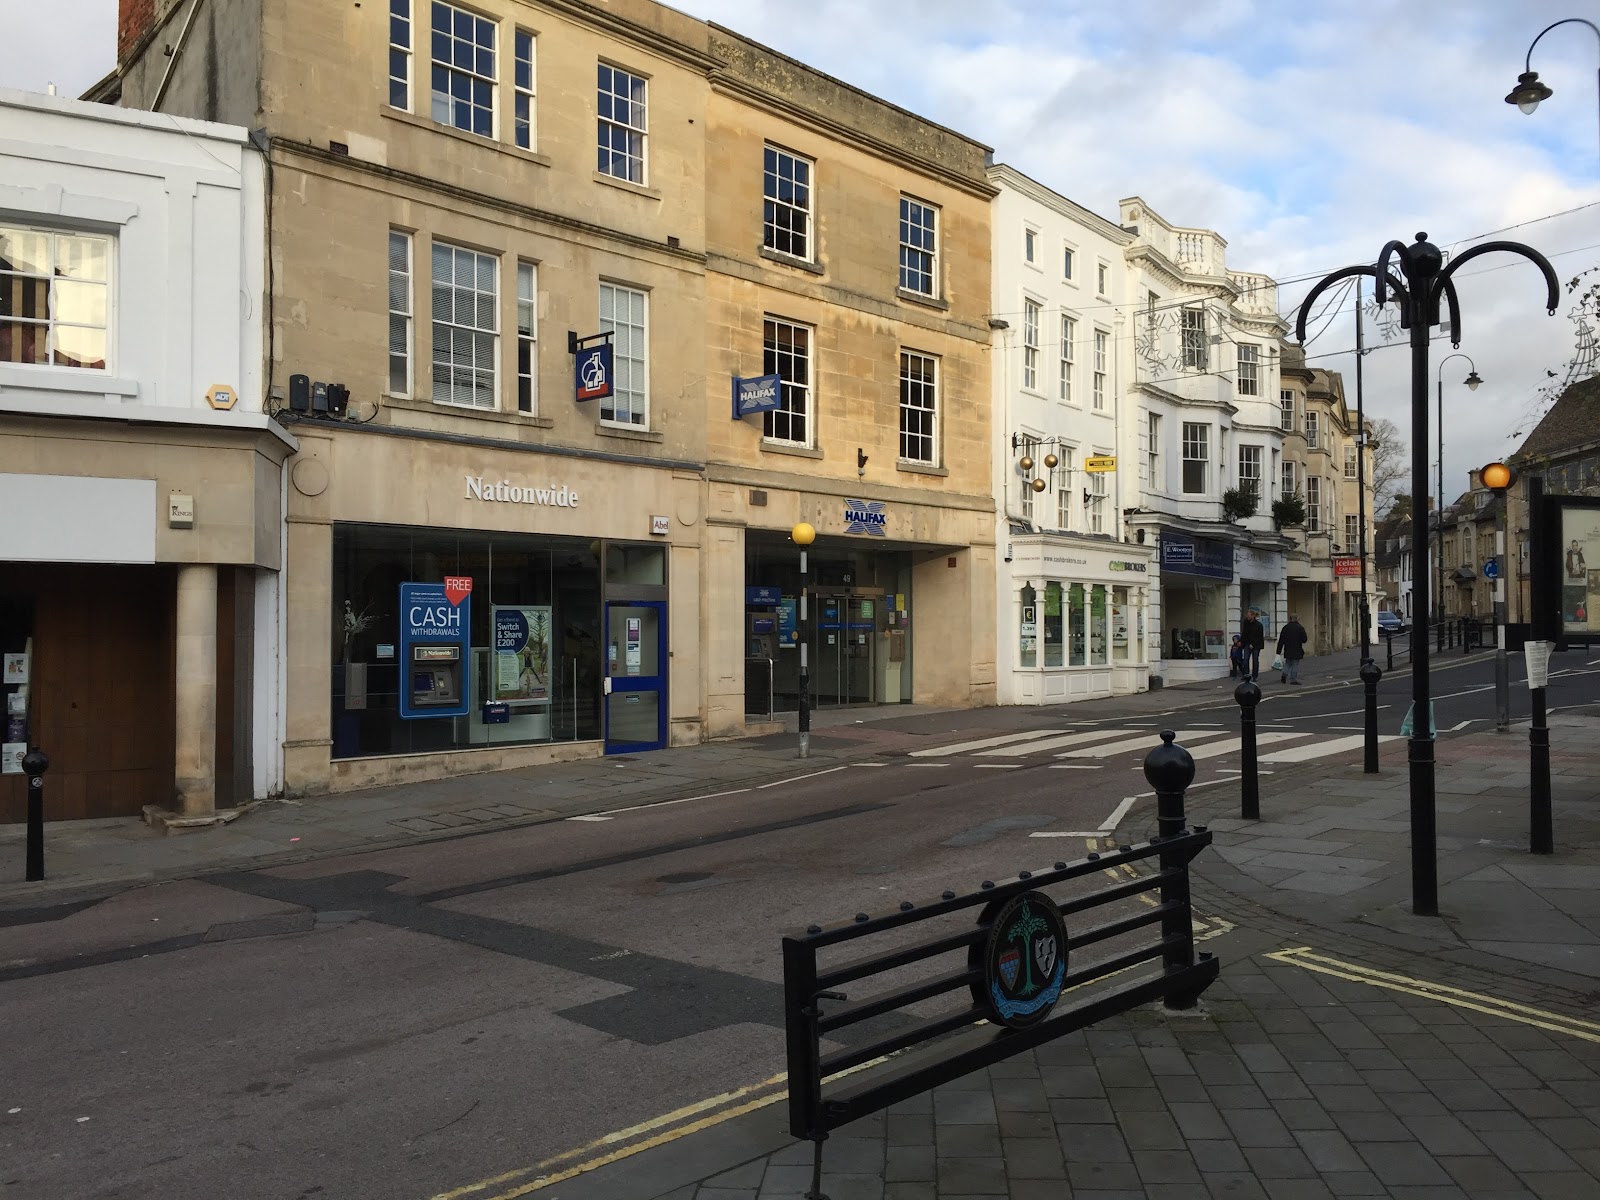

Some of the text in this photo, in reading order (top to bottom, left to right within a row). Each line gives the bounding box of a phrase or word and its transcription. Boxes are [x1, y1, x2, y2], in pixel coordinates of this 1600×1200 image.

[215, 393, 230, 401] ADT
[740, 387, 776, 401] HALIFAX
[464, 475, 579, 508] Nationwide
[845, 510, 886, 525] HALIFAX
[842, 574, 851, 583] 49
[446, 578, 471, 591] FREE
[409, 606, 461, 627] CASH
[497, 622, 520, 631] Switch
[410, 628, 460, 636] WITHDRAWALS
[497, 631, 523, 639] & Share
[497, 638, 516, 647] £200
